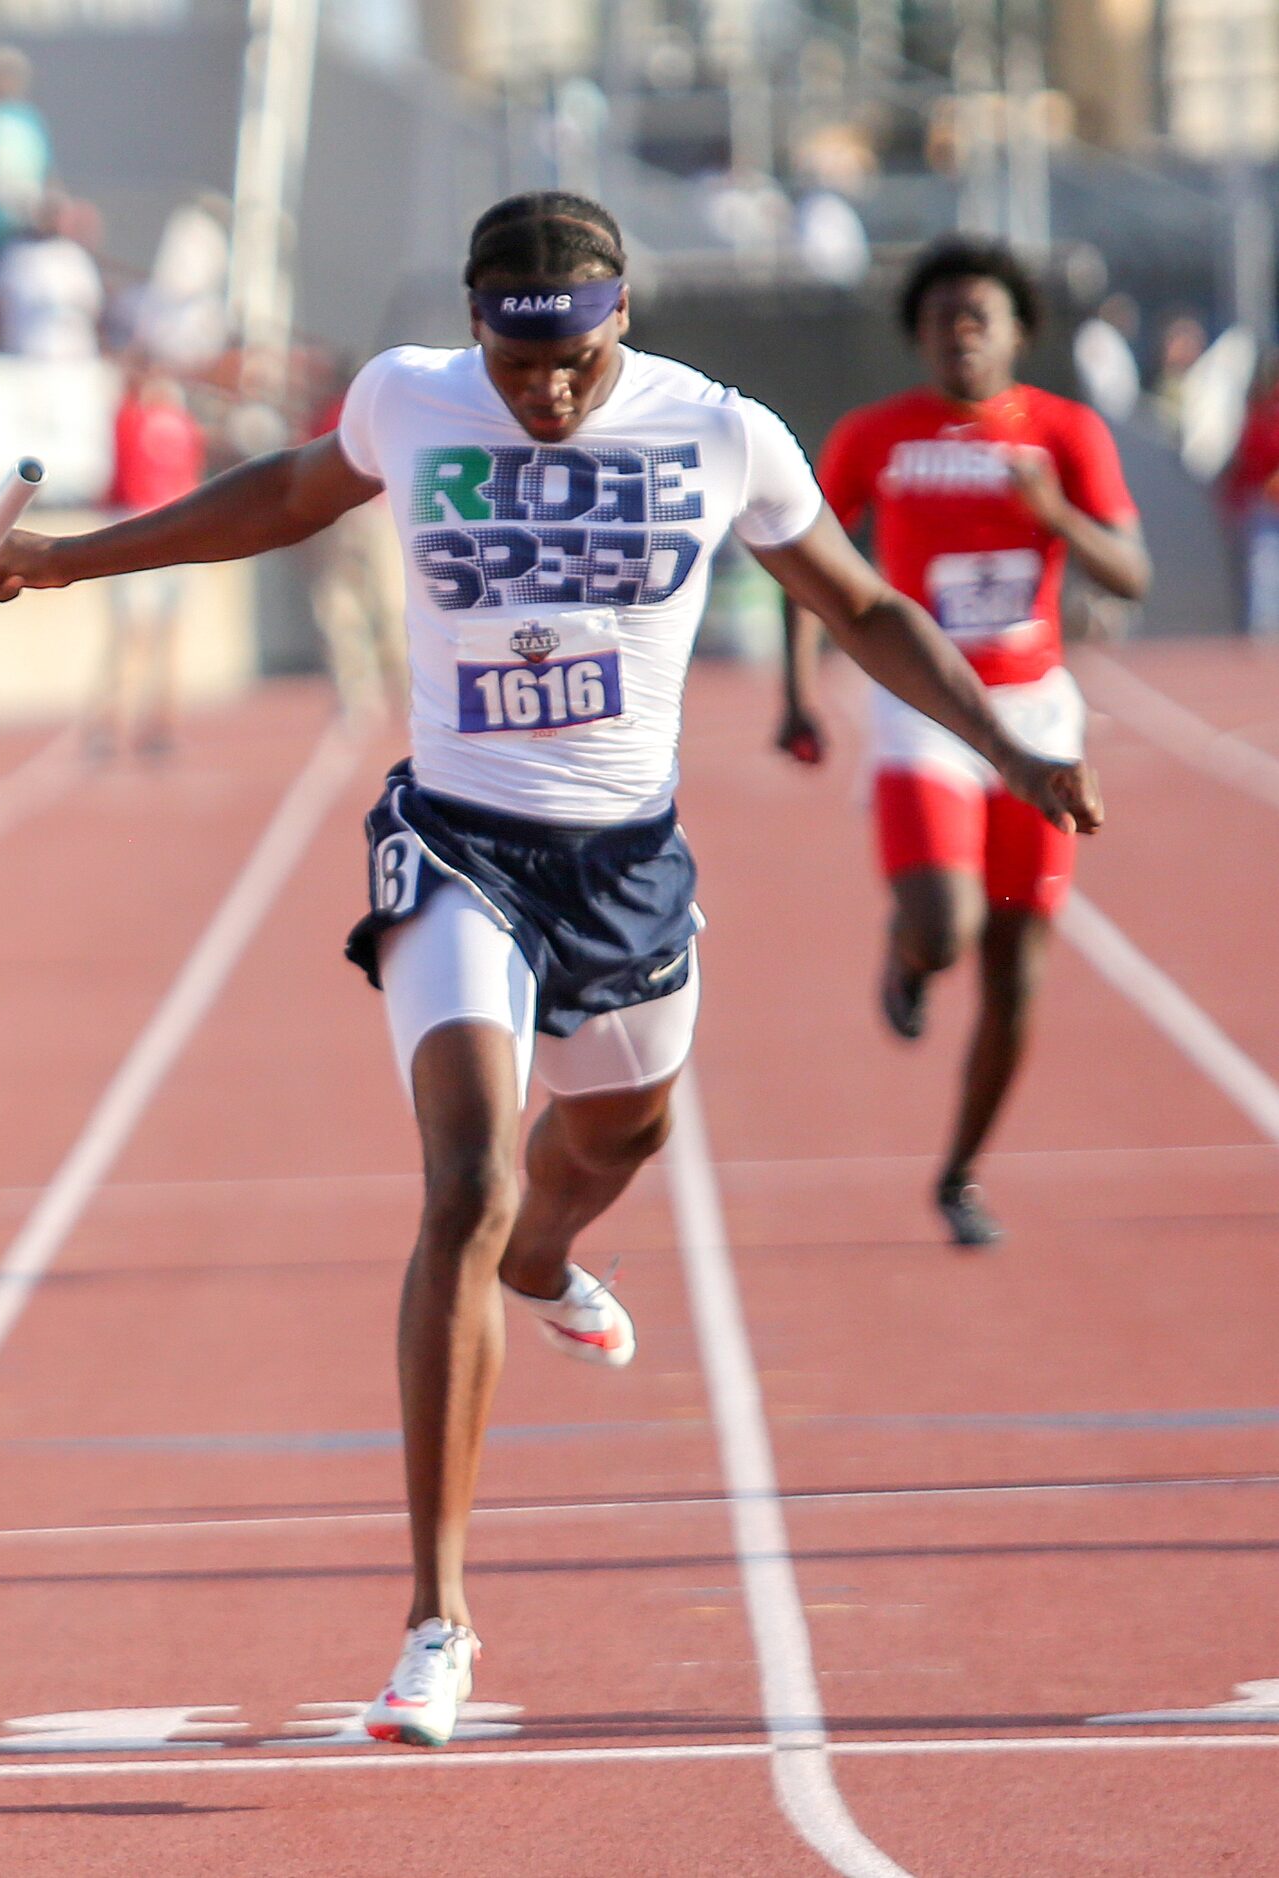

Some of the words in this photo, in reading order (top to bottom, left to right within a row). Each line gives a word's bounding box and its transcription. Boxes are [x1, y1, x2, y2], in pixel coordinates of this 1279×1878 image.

[500, 294, 572, 312] RAMS
[411, 441, 704, 522] RIDGE
[412, 527, 704, 611] SPEED
[510, 636, 560, 650] STATE
[475, 660, 605, 726] 1616
